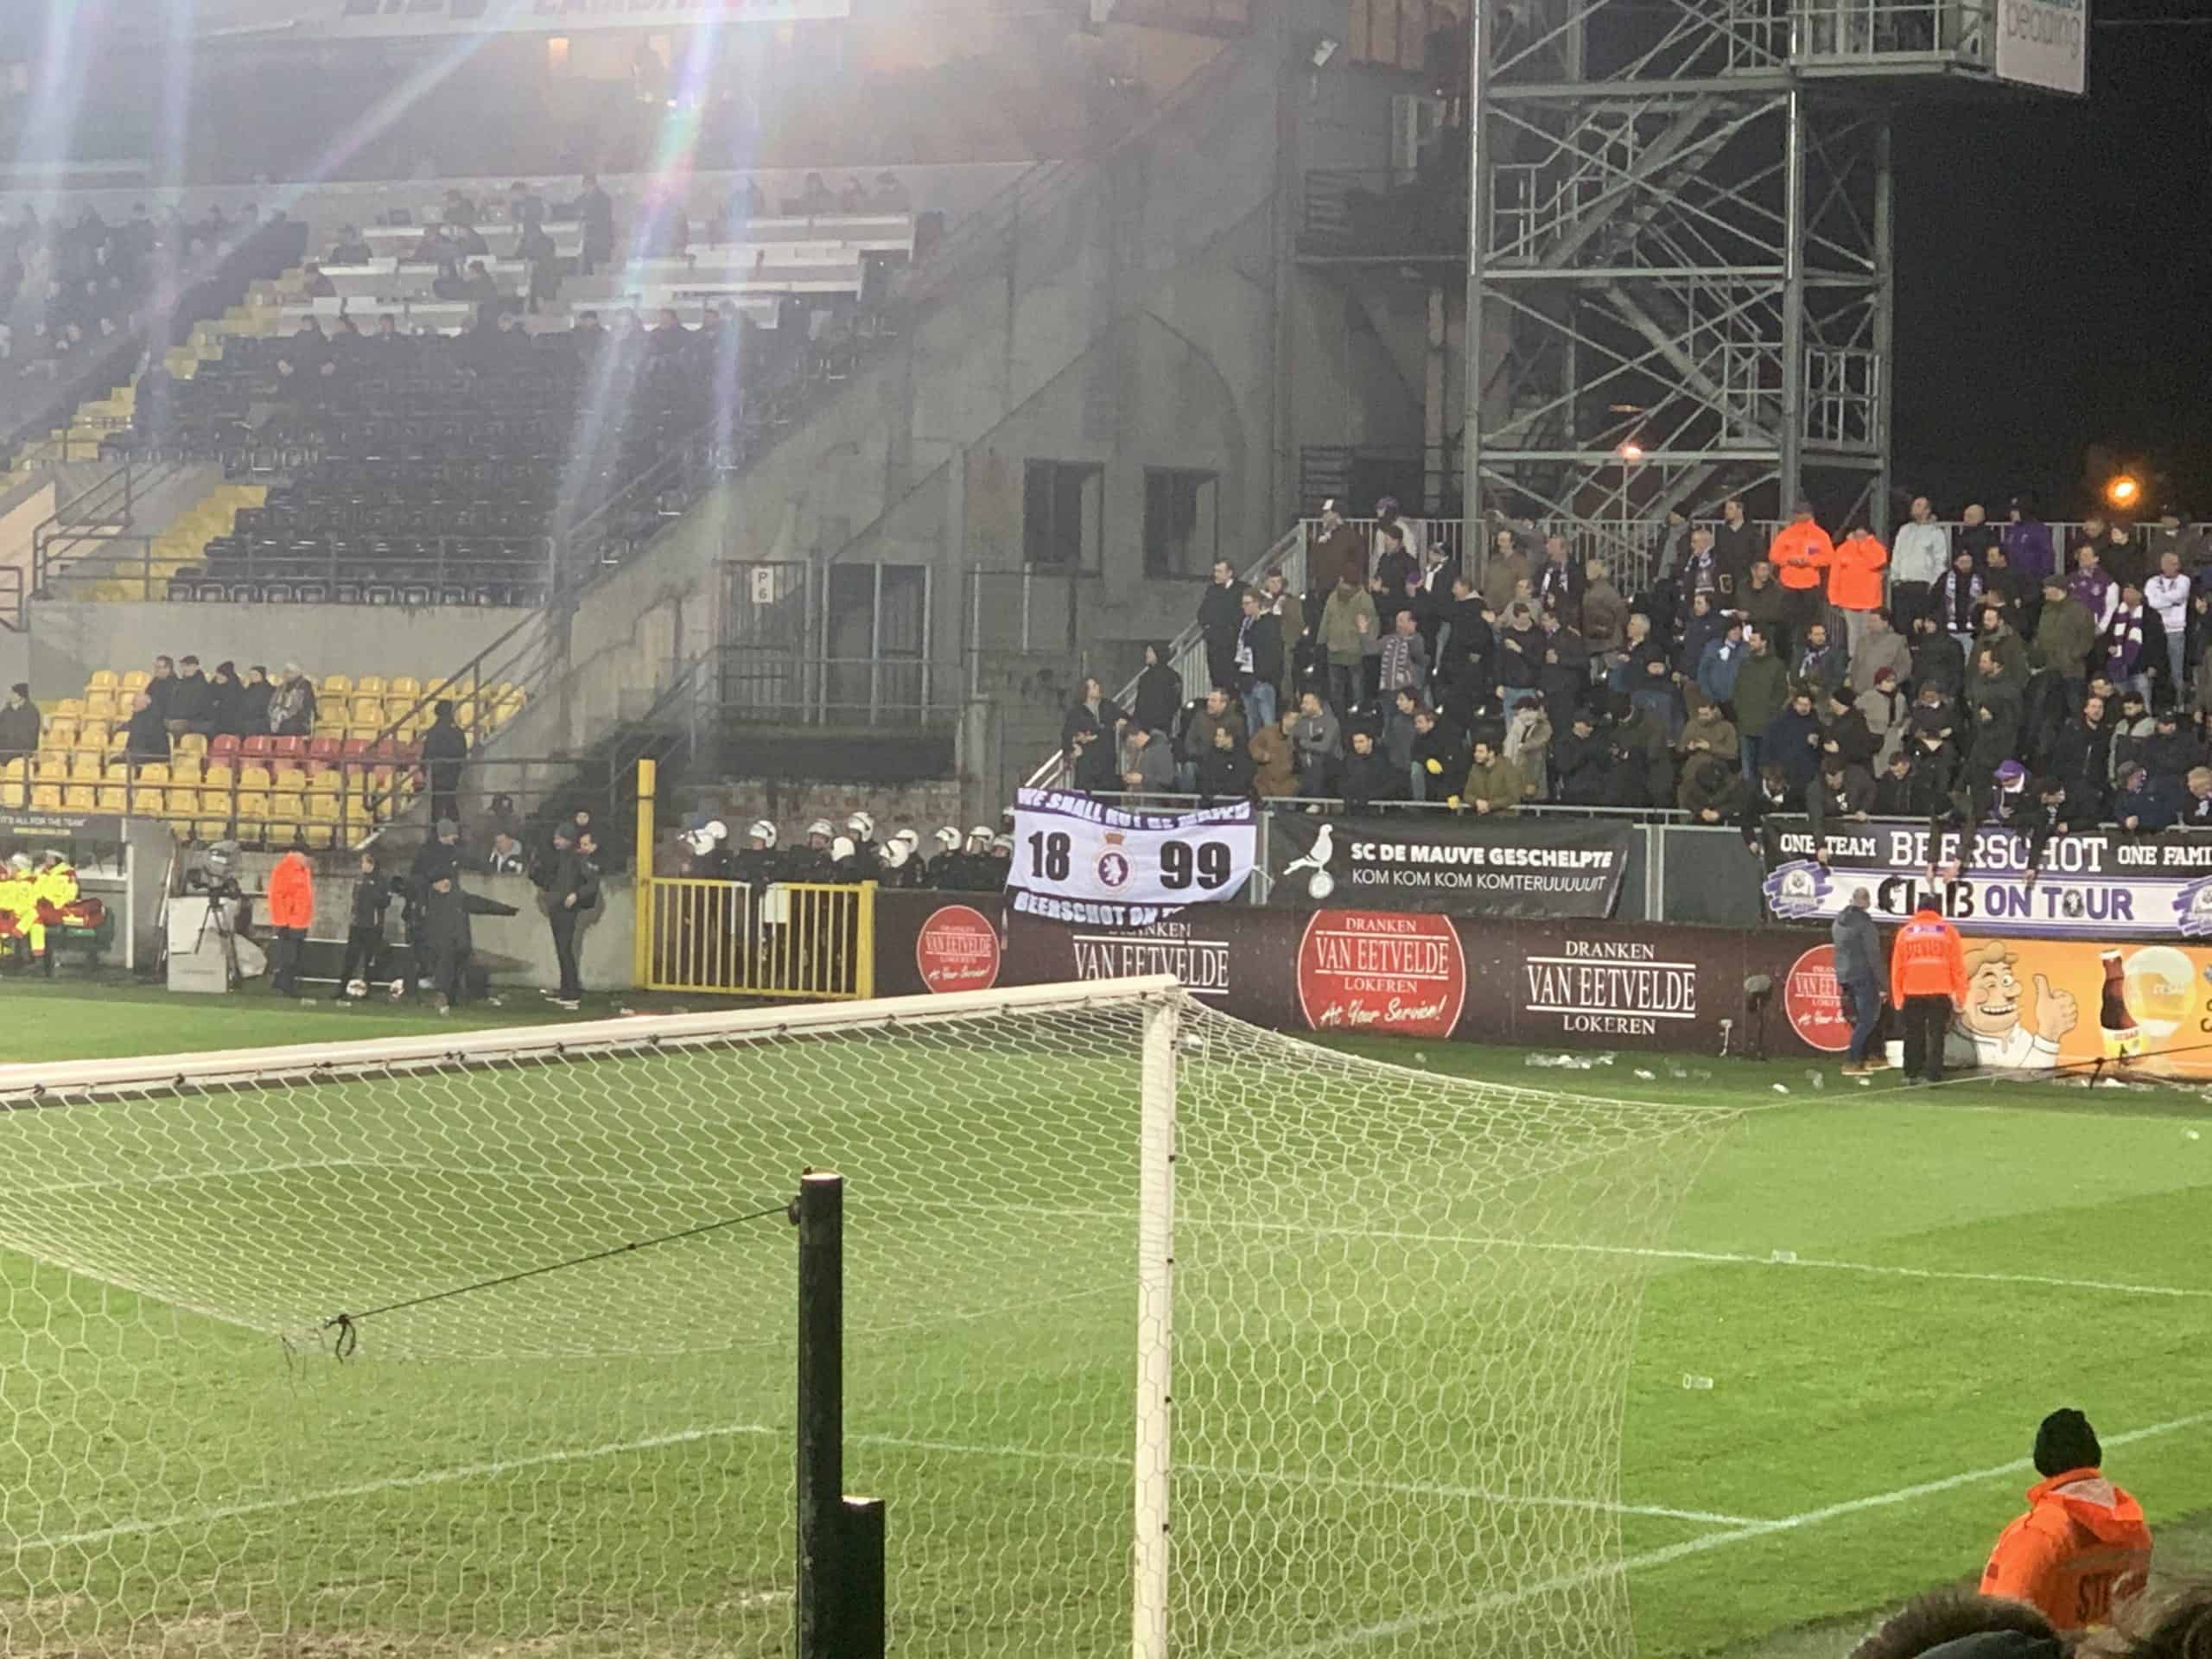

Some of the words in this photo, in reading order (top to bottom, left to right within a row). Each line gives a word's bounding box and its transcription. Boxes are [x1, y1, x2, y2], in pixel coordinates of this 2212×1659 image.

[758, 571, 768, 583] P
[1028, 831, 1071, 882] 18
[1160, 841, 1231, 889] 99
[1351, 842, 1376, 861] SC
[1380, 844, 1406, 861] DE
[1410, 845, 1485, 865] MAUVE
[1489, 848, 1613, 868] GESCHELPTE
[1780, 833, 1815, 855] ONE
[1825, 836, 1877, 856] TEAM
[2117, 845, 2158, 865] ONE
[1352, 868, 1389, 884] KOM
[1393, 870, 1430, 887] KOM
[1434, 872, 1472, 887] KOM
[1014, 891, 1125, 925] BEERSCHOT
[1985, 885, 2032, 917] ON
[1345, 918, 1417, 932] DRANKEN
[1073, 943, 1115, 980] VAN
[1122, 945, 1230, 987] EETVELDE
[1316, 938, 1351, 969] VAN
[1357, 939, 1449, 974] EETVELDE
[1565, 940, 1655, 959] DRANKEN
[1344, 977, 1418, 993] LOKEREN
[1527, 964, 1572, 1005] VAN
[1578, 967, 1696, 1011] EETVELDE
[1320, 1001, 1343, 1026] At
[1347, 998, 1380, 1027] Your
[1384, 995, 1448, 1022] Service!
[1563, 1014, 1656, 1035] LOKEREN
